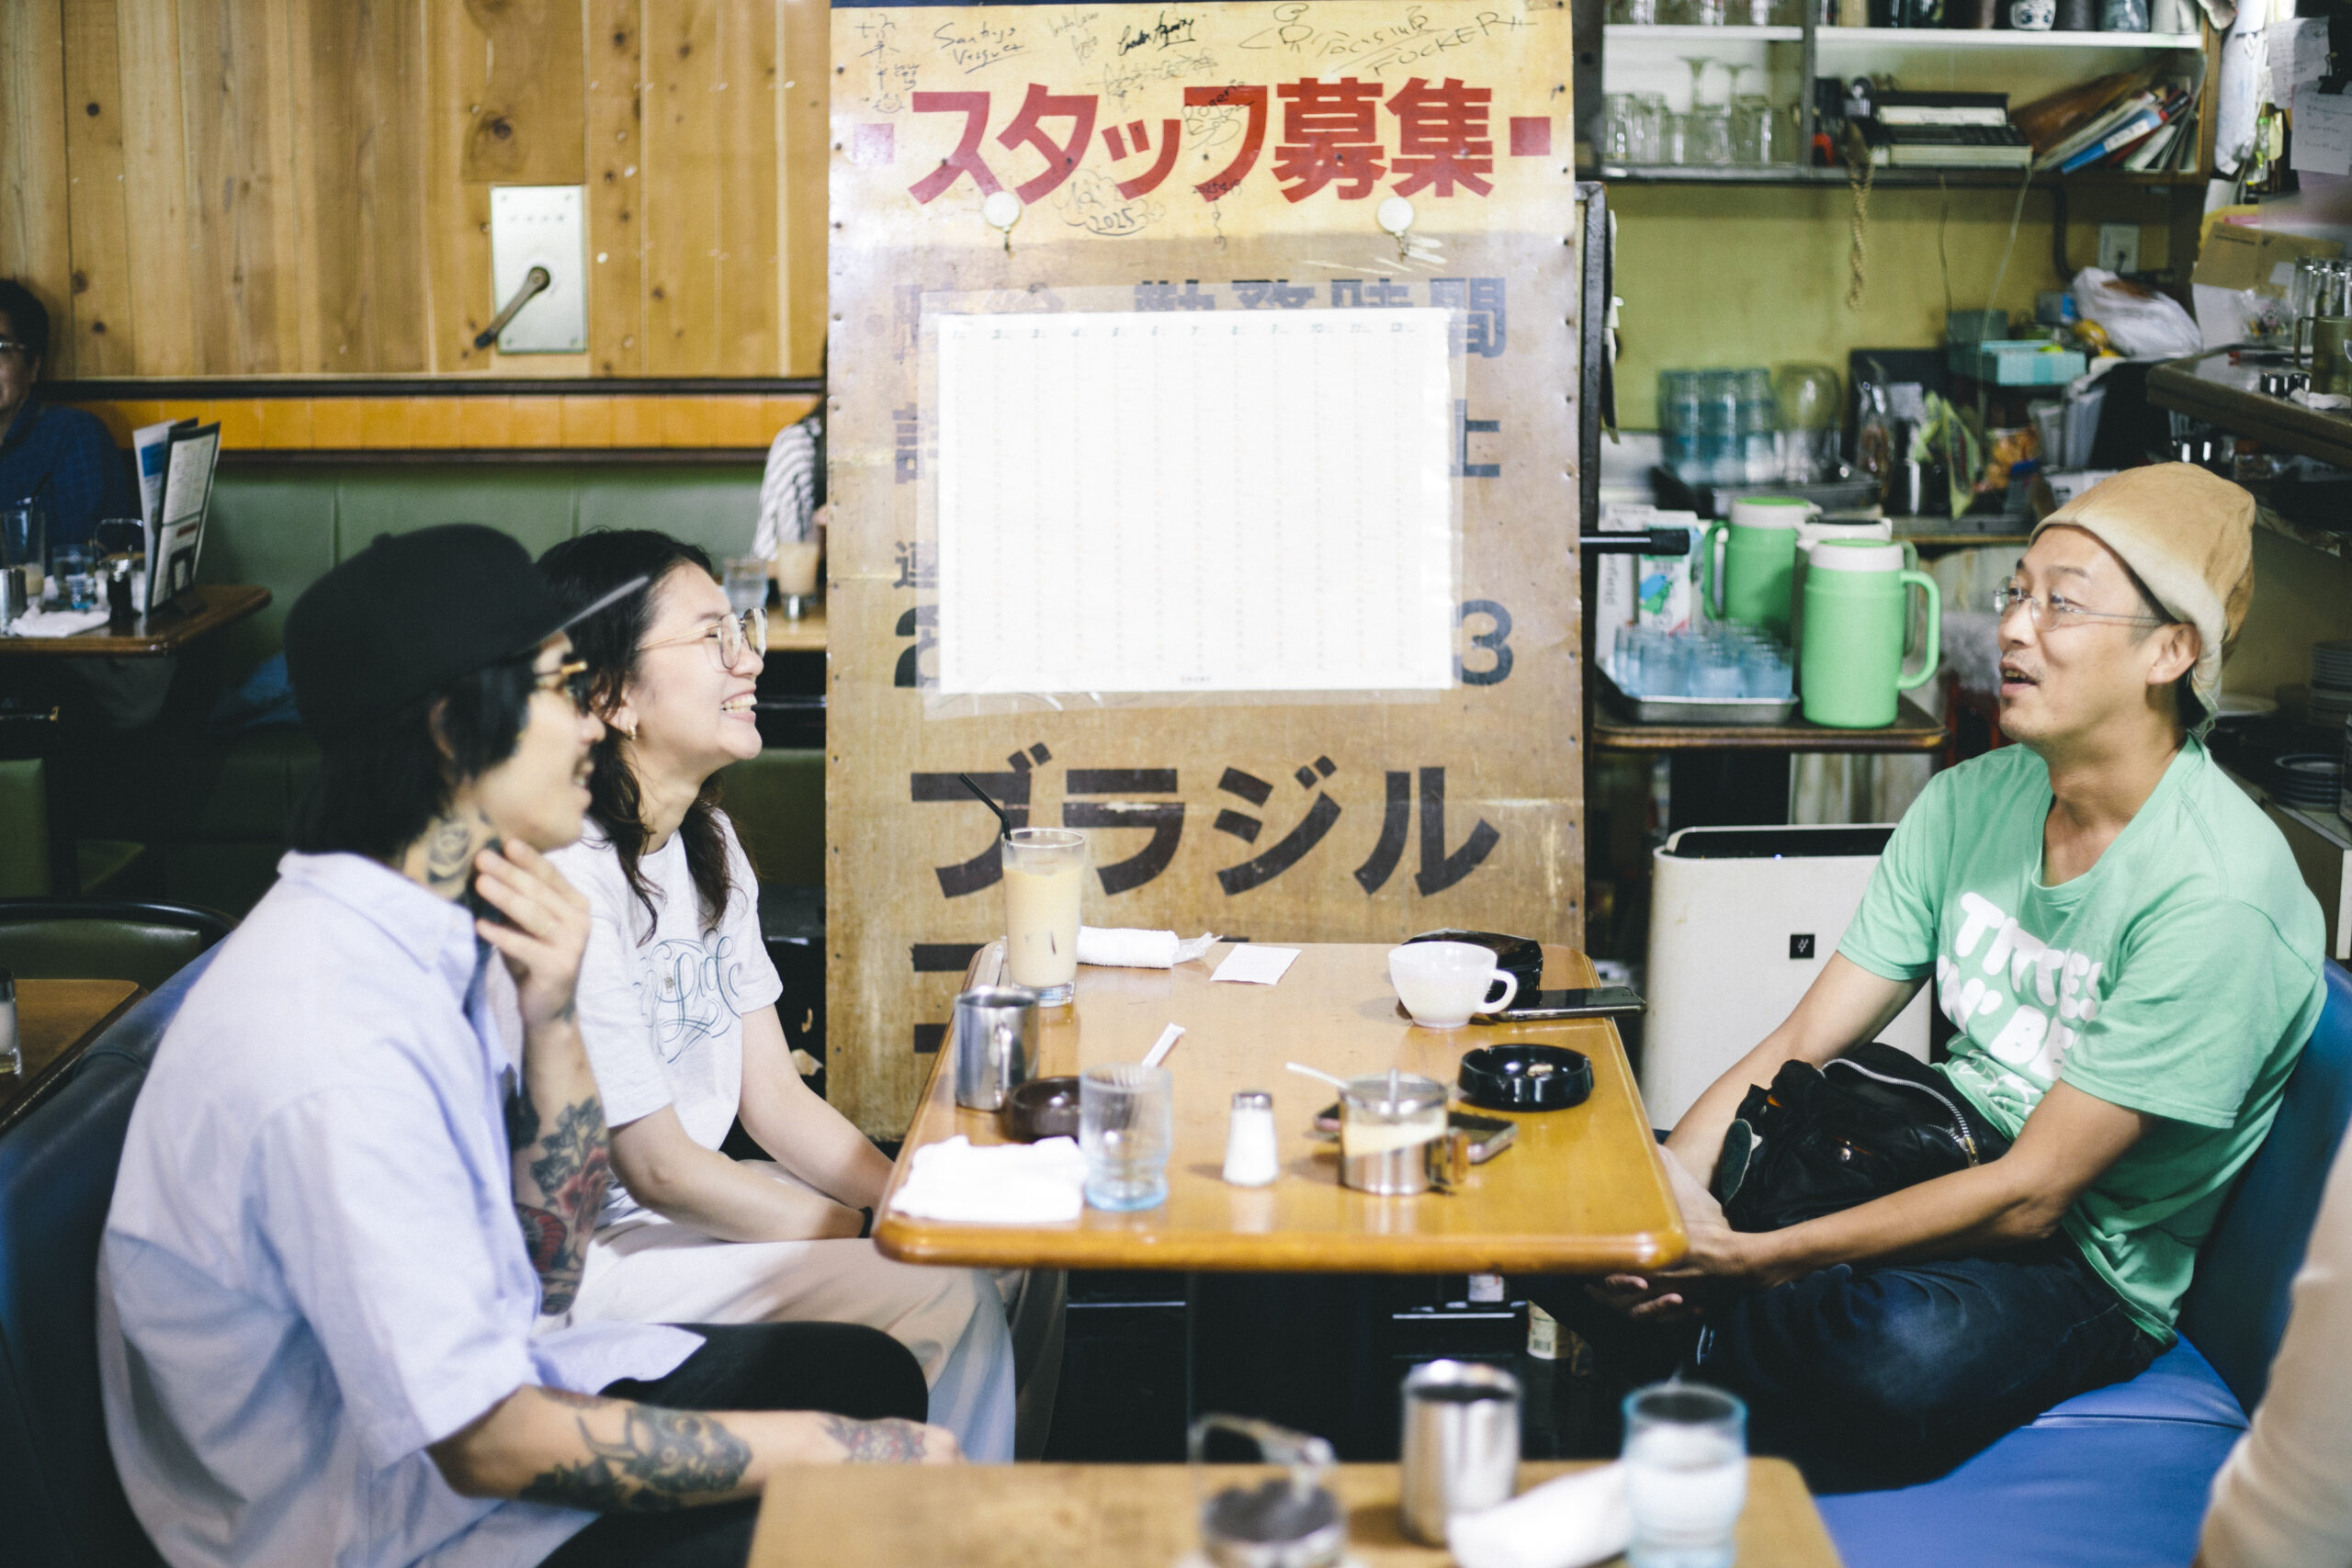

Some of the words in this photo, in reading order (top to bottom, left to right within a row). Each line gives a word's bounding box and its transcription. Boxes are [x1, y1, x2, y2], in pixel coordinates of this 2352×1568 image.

[909, 76, 1496, 206] スタッフ募集
[1089, 207, 1136, 231] 2025
[910, 741, 1501, 897] ブラジル
